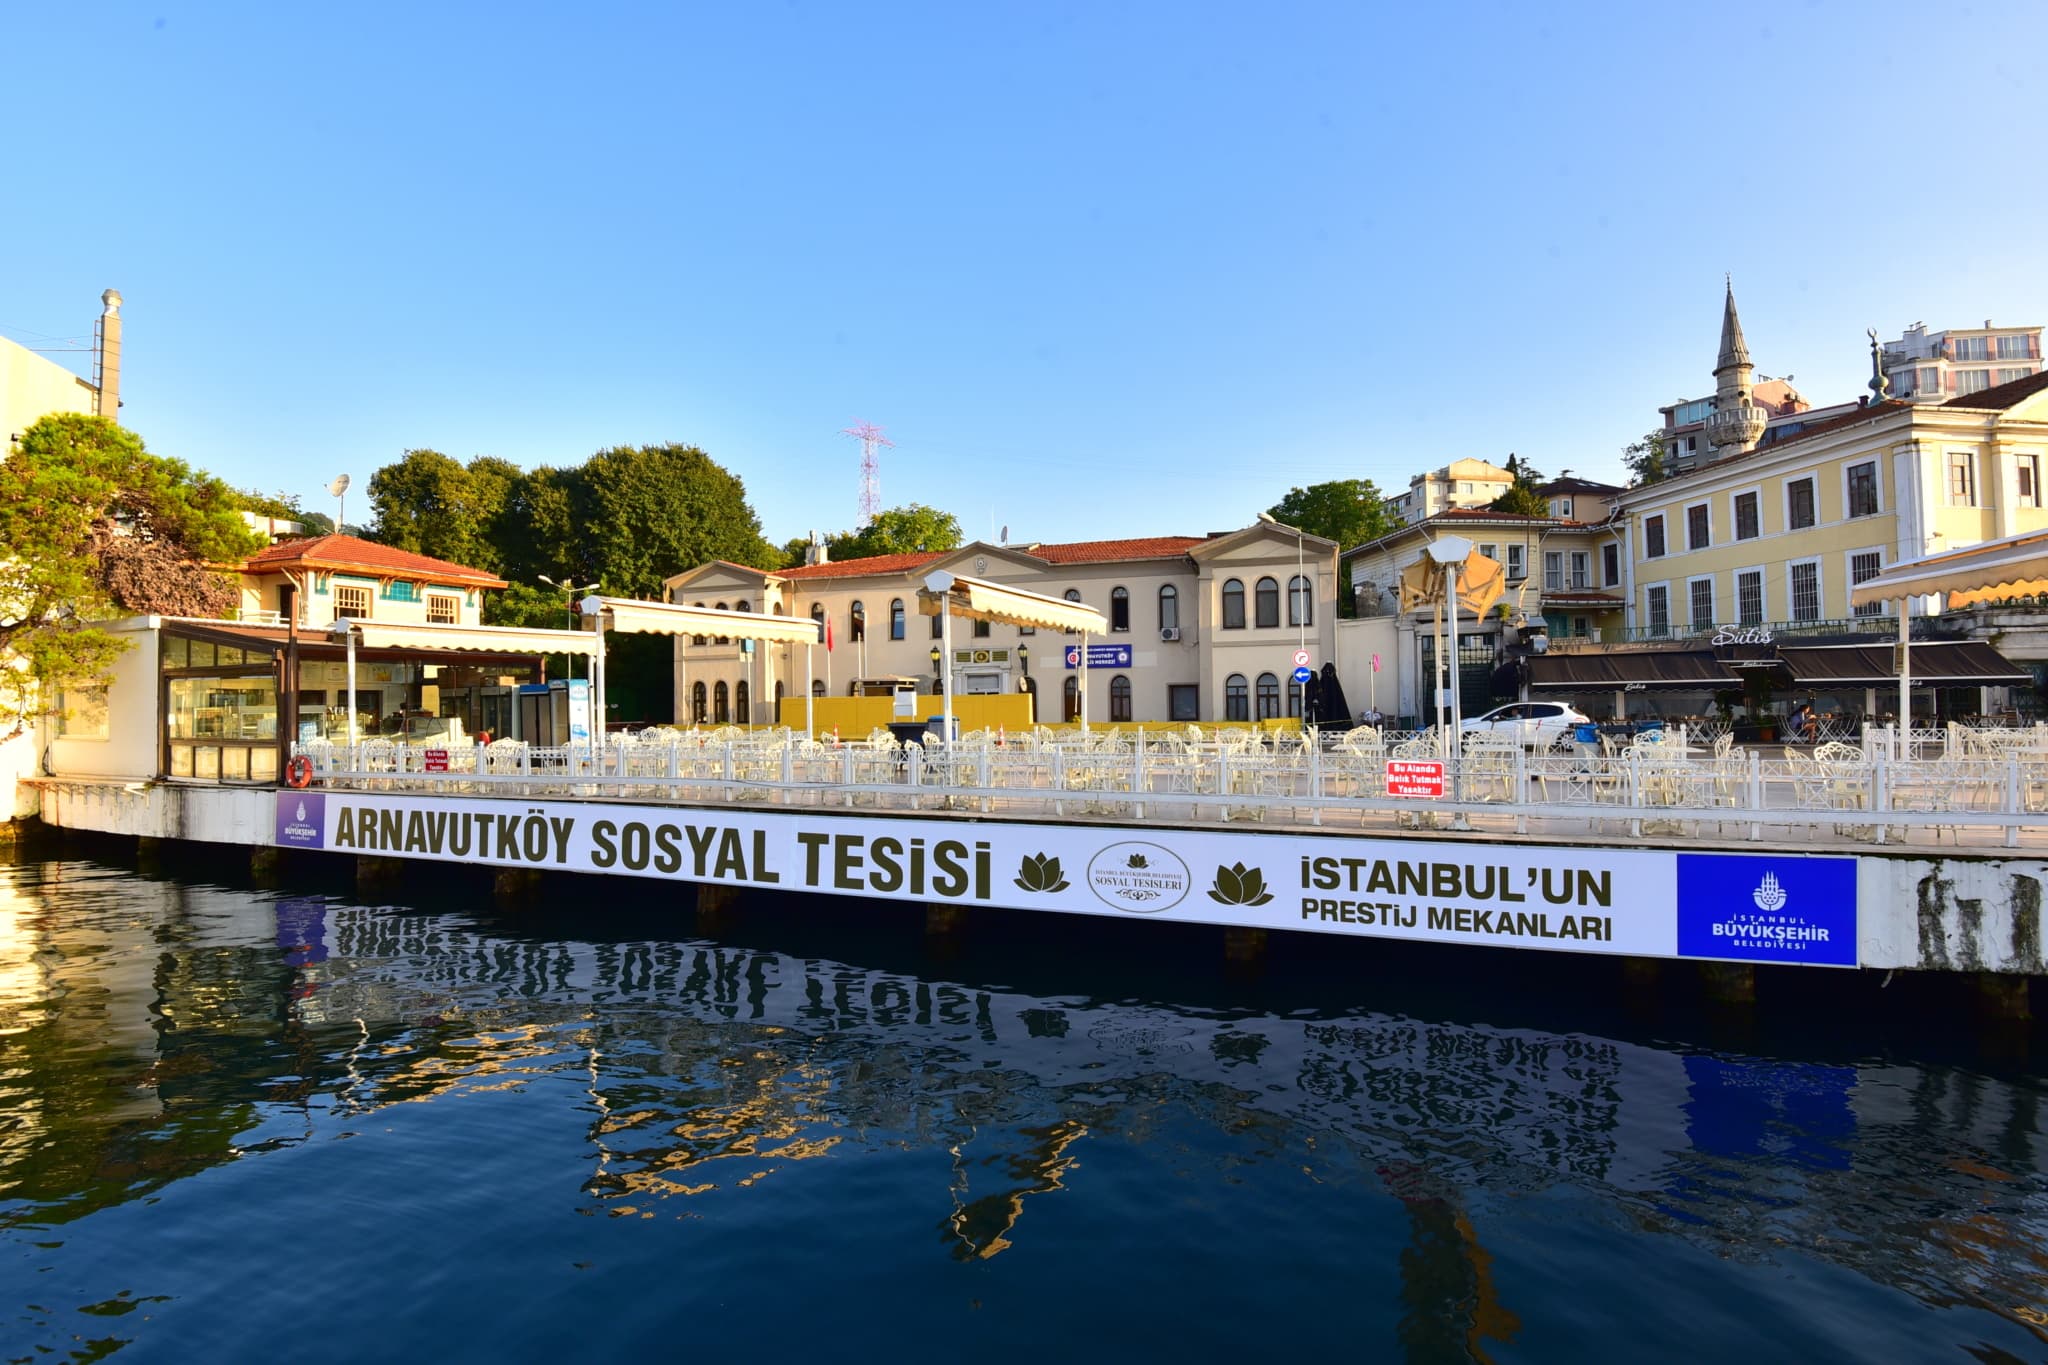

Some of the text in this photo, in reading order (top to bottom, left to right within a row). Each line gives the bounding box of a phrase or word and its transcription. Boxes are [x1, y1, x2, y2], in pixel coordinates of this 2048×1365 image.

[1394, 764, 1436, 773] Bu Alanda
[1411, 774, 1442, 784] Tutmak
[335, 807, 991, 900] ARNAVUTKÖY SOSYAL TESİSİ
[1095, 876, 1130, 888] SOSYAL
[1301, 897, 1612, 942] PRESTİJ MEKANLARI
[1733, 913, 1806, 925] İSTANBUL
[1712, 920, 1830, 944] BÜYÜKŞEHİR
[1733, 939, 1806, 950] BELEDİYESİ
